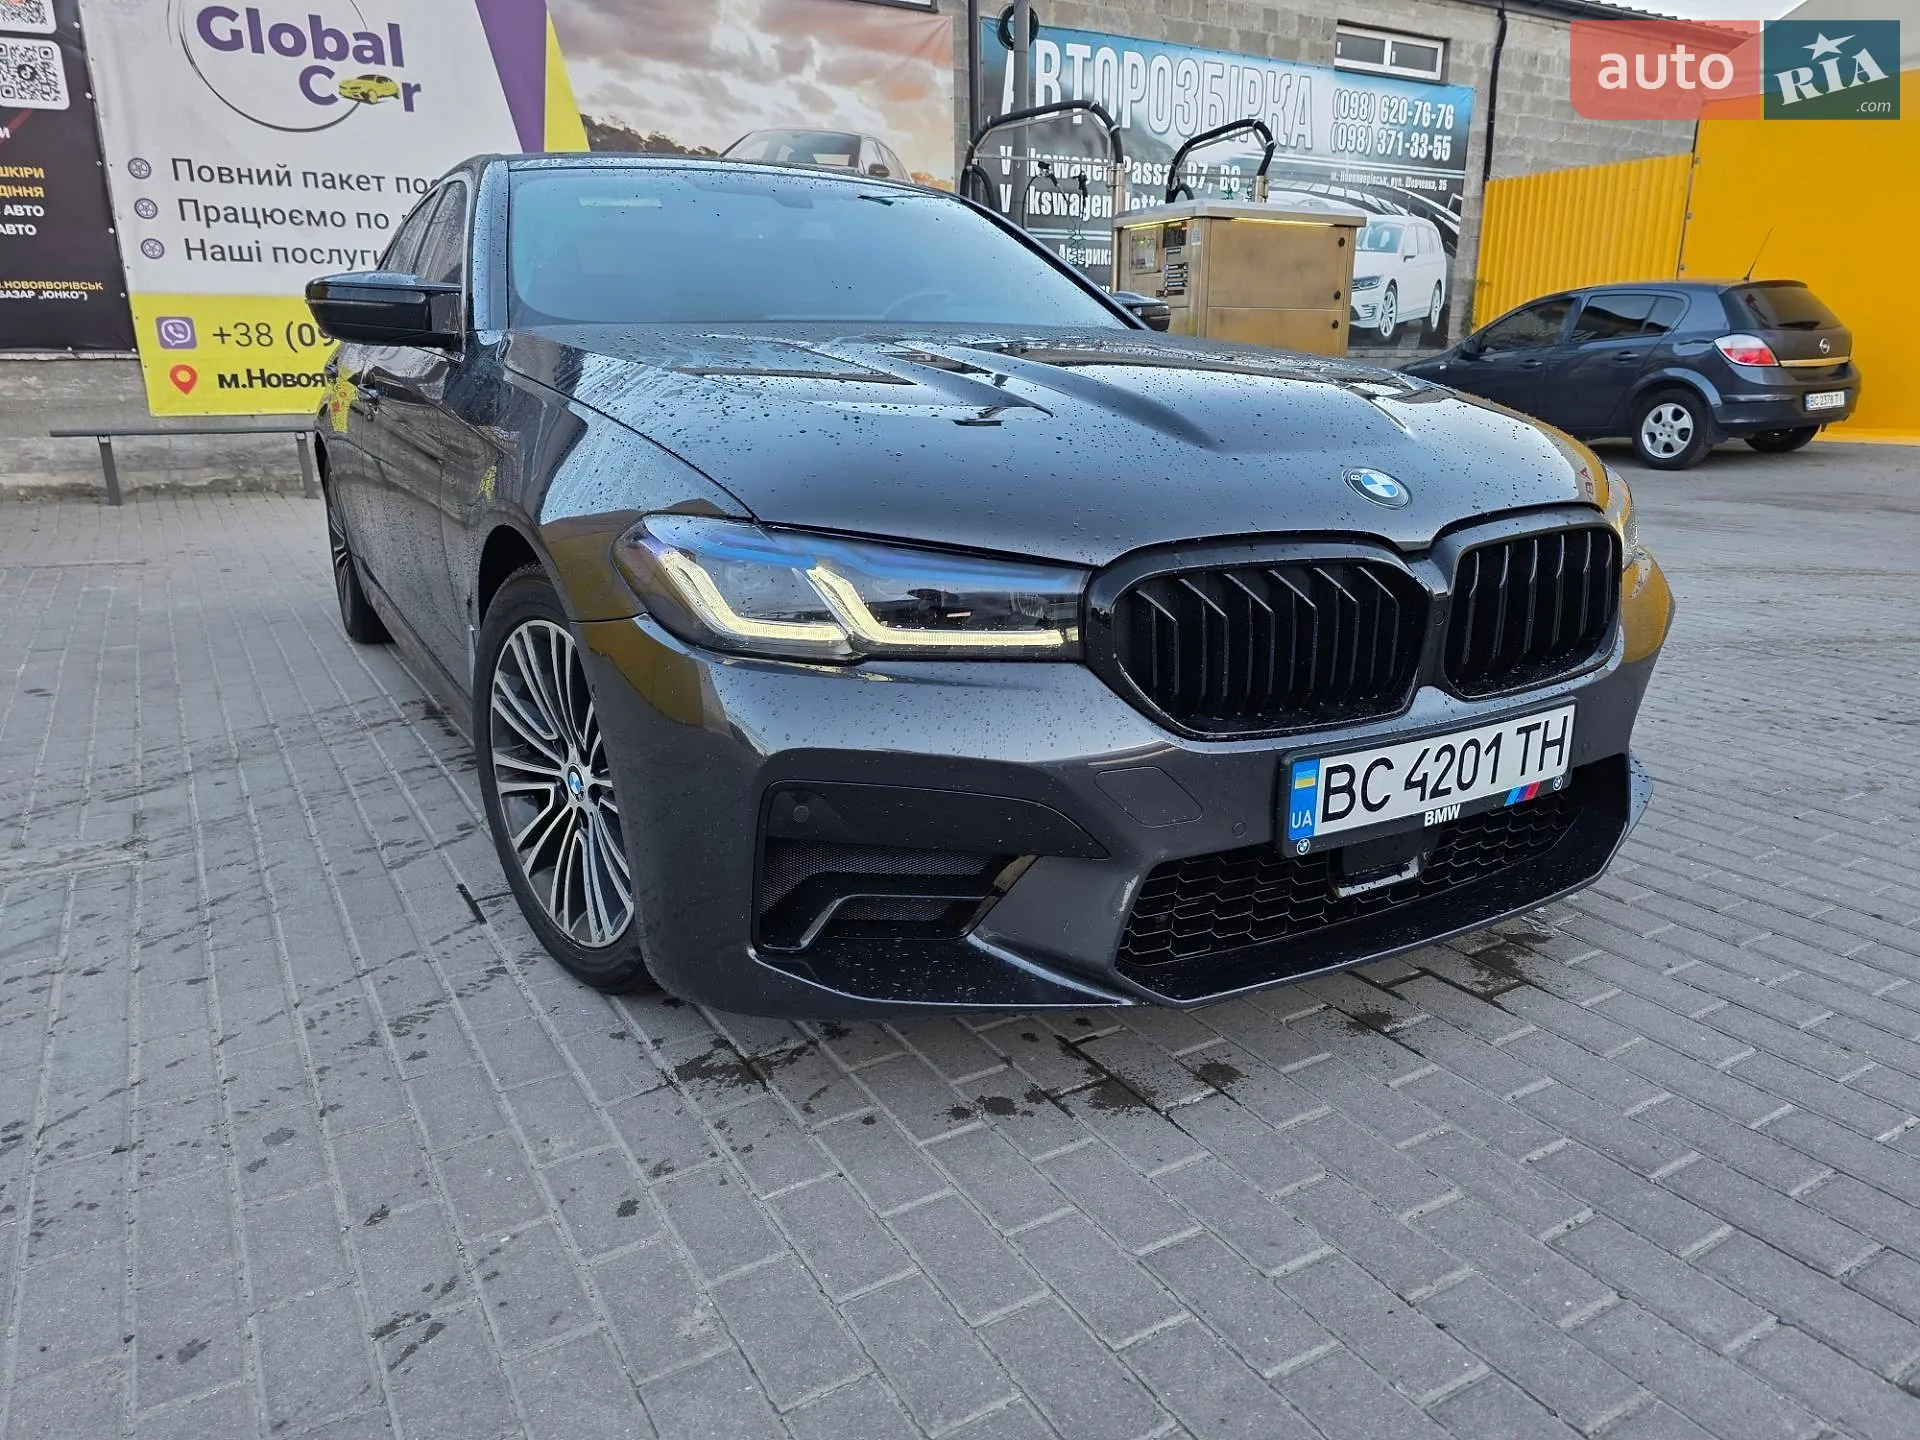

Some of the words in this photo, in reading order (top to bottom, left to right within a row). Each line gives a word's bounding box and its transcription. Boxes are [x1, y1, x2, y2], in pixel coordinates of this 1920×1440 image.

[196, 5, 404, 68] Global
[1333, 90, 1374, 124] (098)
[1380, 96, 1453, 130] 620-76-76
[1331, 122, 1371, 155] (098)
[1377, 129, 1452, 161] 371-33-55
[171, 157, 292, 188] Повний
[302, 170, 385, 192] пакет
[1000, 145, 1111, 184] Vlkwagen
[1121, 155, 1171, 186] Passa
[4, 205, 45, 217] АВТО
[178, 198, 346, 229] Працюємо
[356, 212, 390, 230] по
[1000, 184, 1112, 222] Vlkswagen
[184, 238, 262, 263] Наші
[0, 280, 104, 290] .НОВОЯВОРІВСЬК
[212, 322, 274, 347] +38
[1321, 757, 1394, 823] BC
[1404, 732, 1502, 801] 4201
[1516, 715, 1568, 776] TH
[1291, 811, 1313, 829] UA
[1424, 804, 1461, 827] BMW
